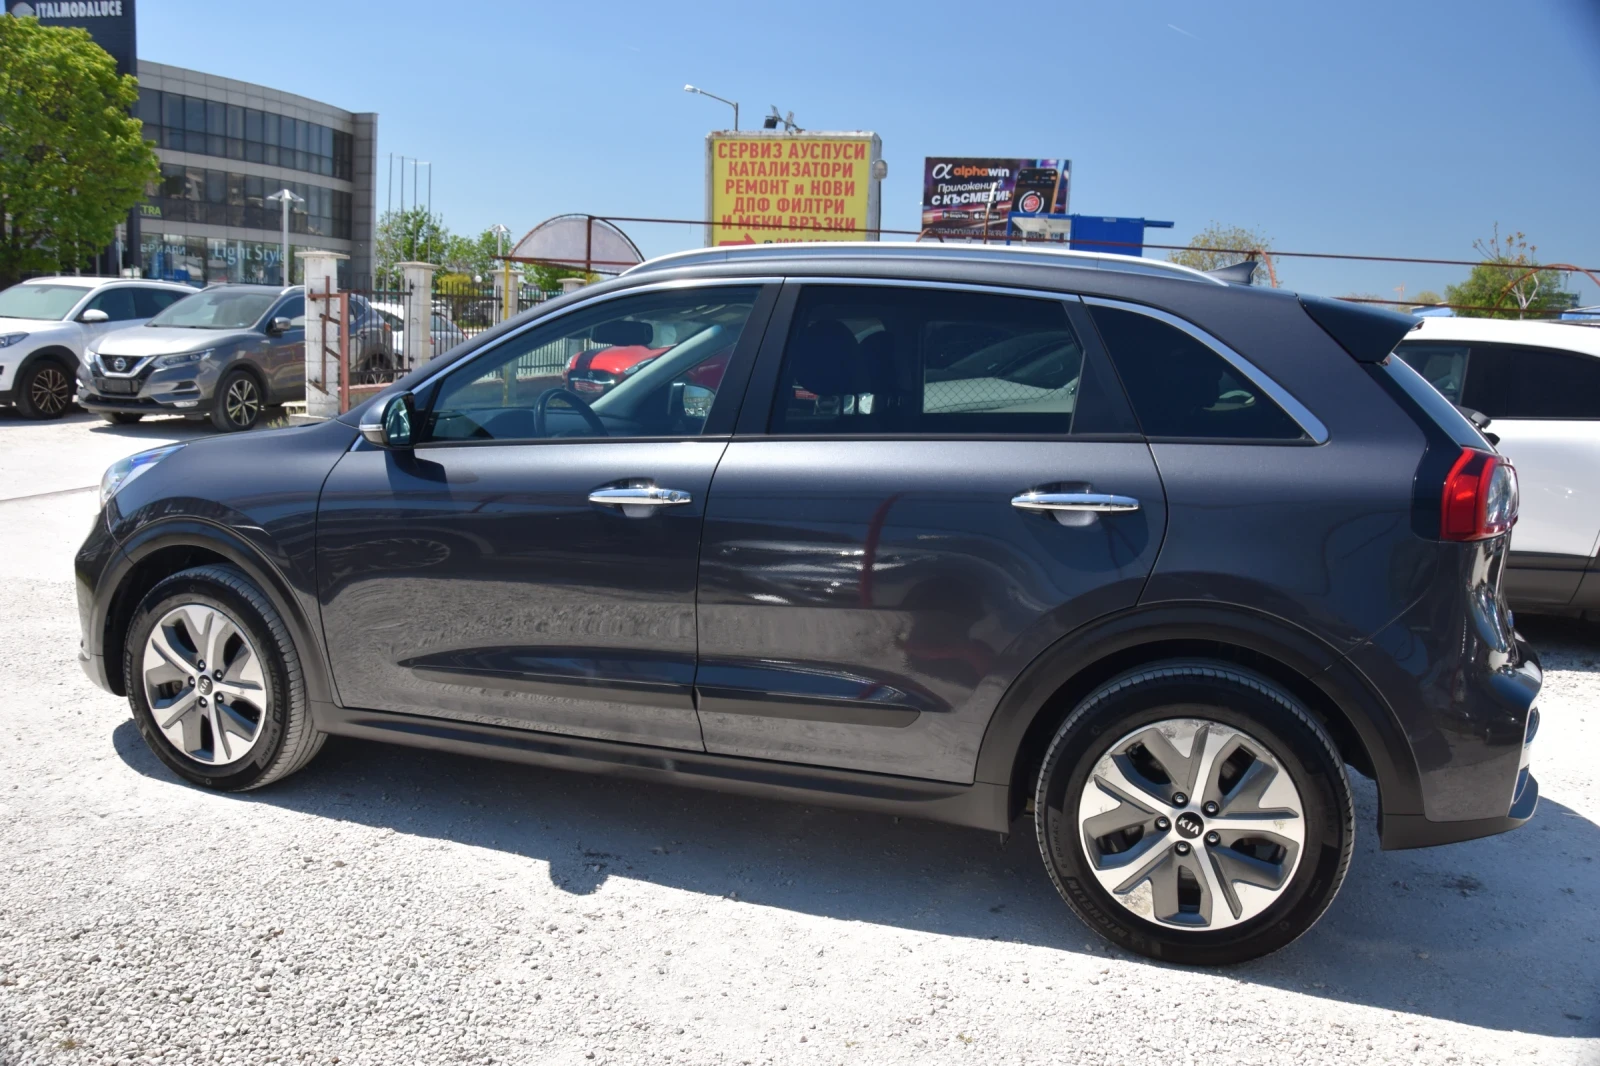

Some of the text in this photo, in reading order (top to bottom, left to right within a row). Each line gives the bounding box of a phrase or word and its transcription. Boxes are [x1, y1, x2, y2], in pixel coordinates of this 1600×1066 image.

[35, 1, 122, 18] ITALMODALUCE
[718, 142, 866, 160] СЕРВИЗ АУСПУСИ
[728, 161, 853, 178] КАТАЛИЗАТОРИ
[953, 165, 1010, 178] alphawin
[725, 179, 855, 196] РЕМОНТ и НОВИ
[938, 180, 1003, 194] Приложени?
[140, 205, 162, 216] TRA
[733, 197, 845, 215] ДПФ ФИЛТРИ
[721, 214, 856, 234] И МЕКИ ВРЪЗКИ
[214, 241, 252, 266] Light
[200, 678, 210, 694] KIA
[1178, 817, 1200, 836] KIA
[1065, 878, 1130, 938] MICHELIN
